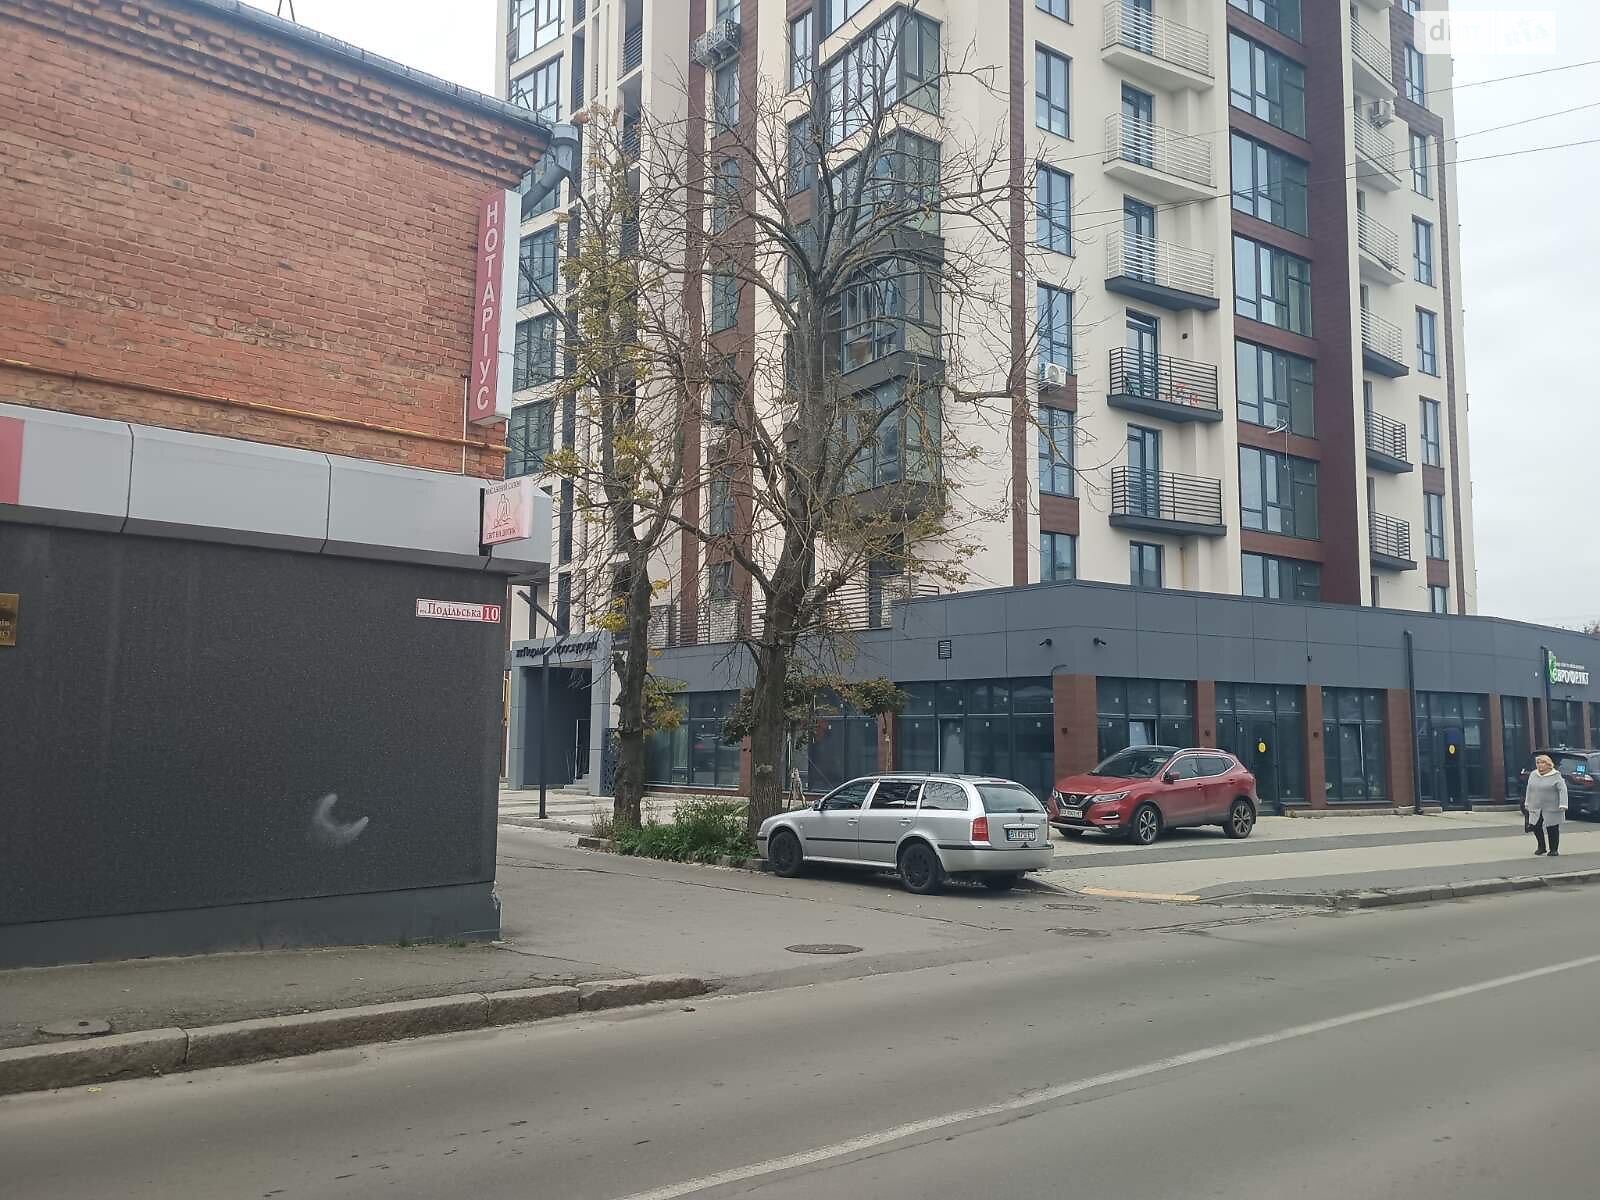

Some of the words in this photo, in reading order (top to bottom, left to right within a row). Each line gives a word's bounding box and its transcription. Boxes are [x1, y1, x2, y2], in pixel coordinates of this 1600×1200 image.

[476, 200, 498, 411] НОТАРІУС
[427, 602, 481, 618] Подільська
[483, 607, 499, 621] 10
